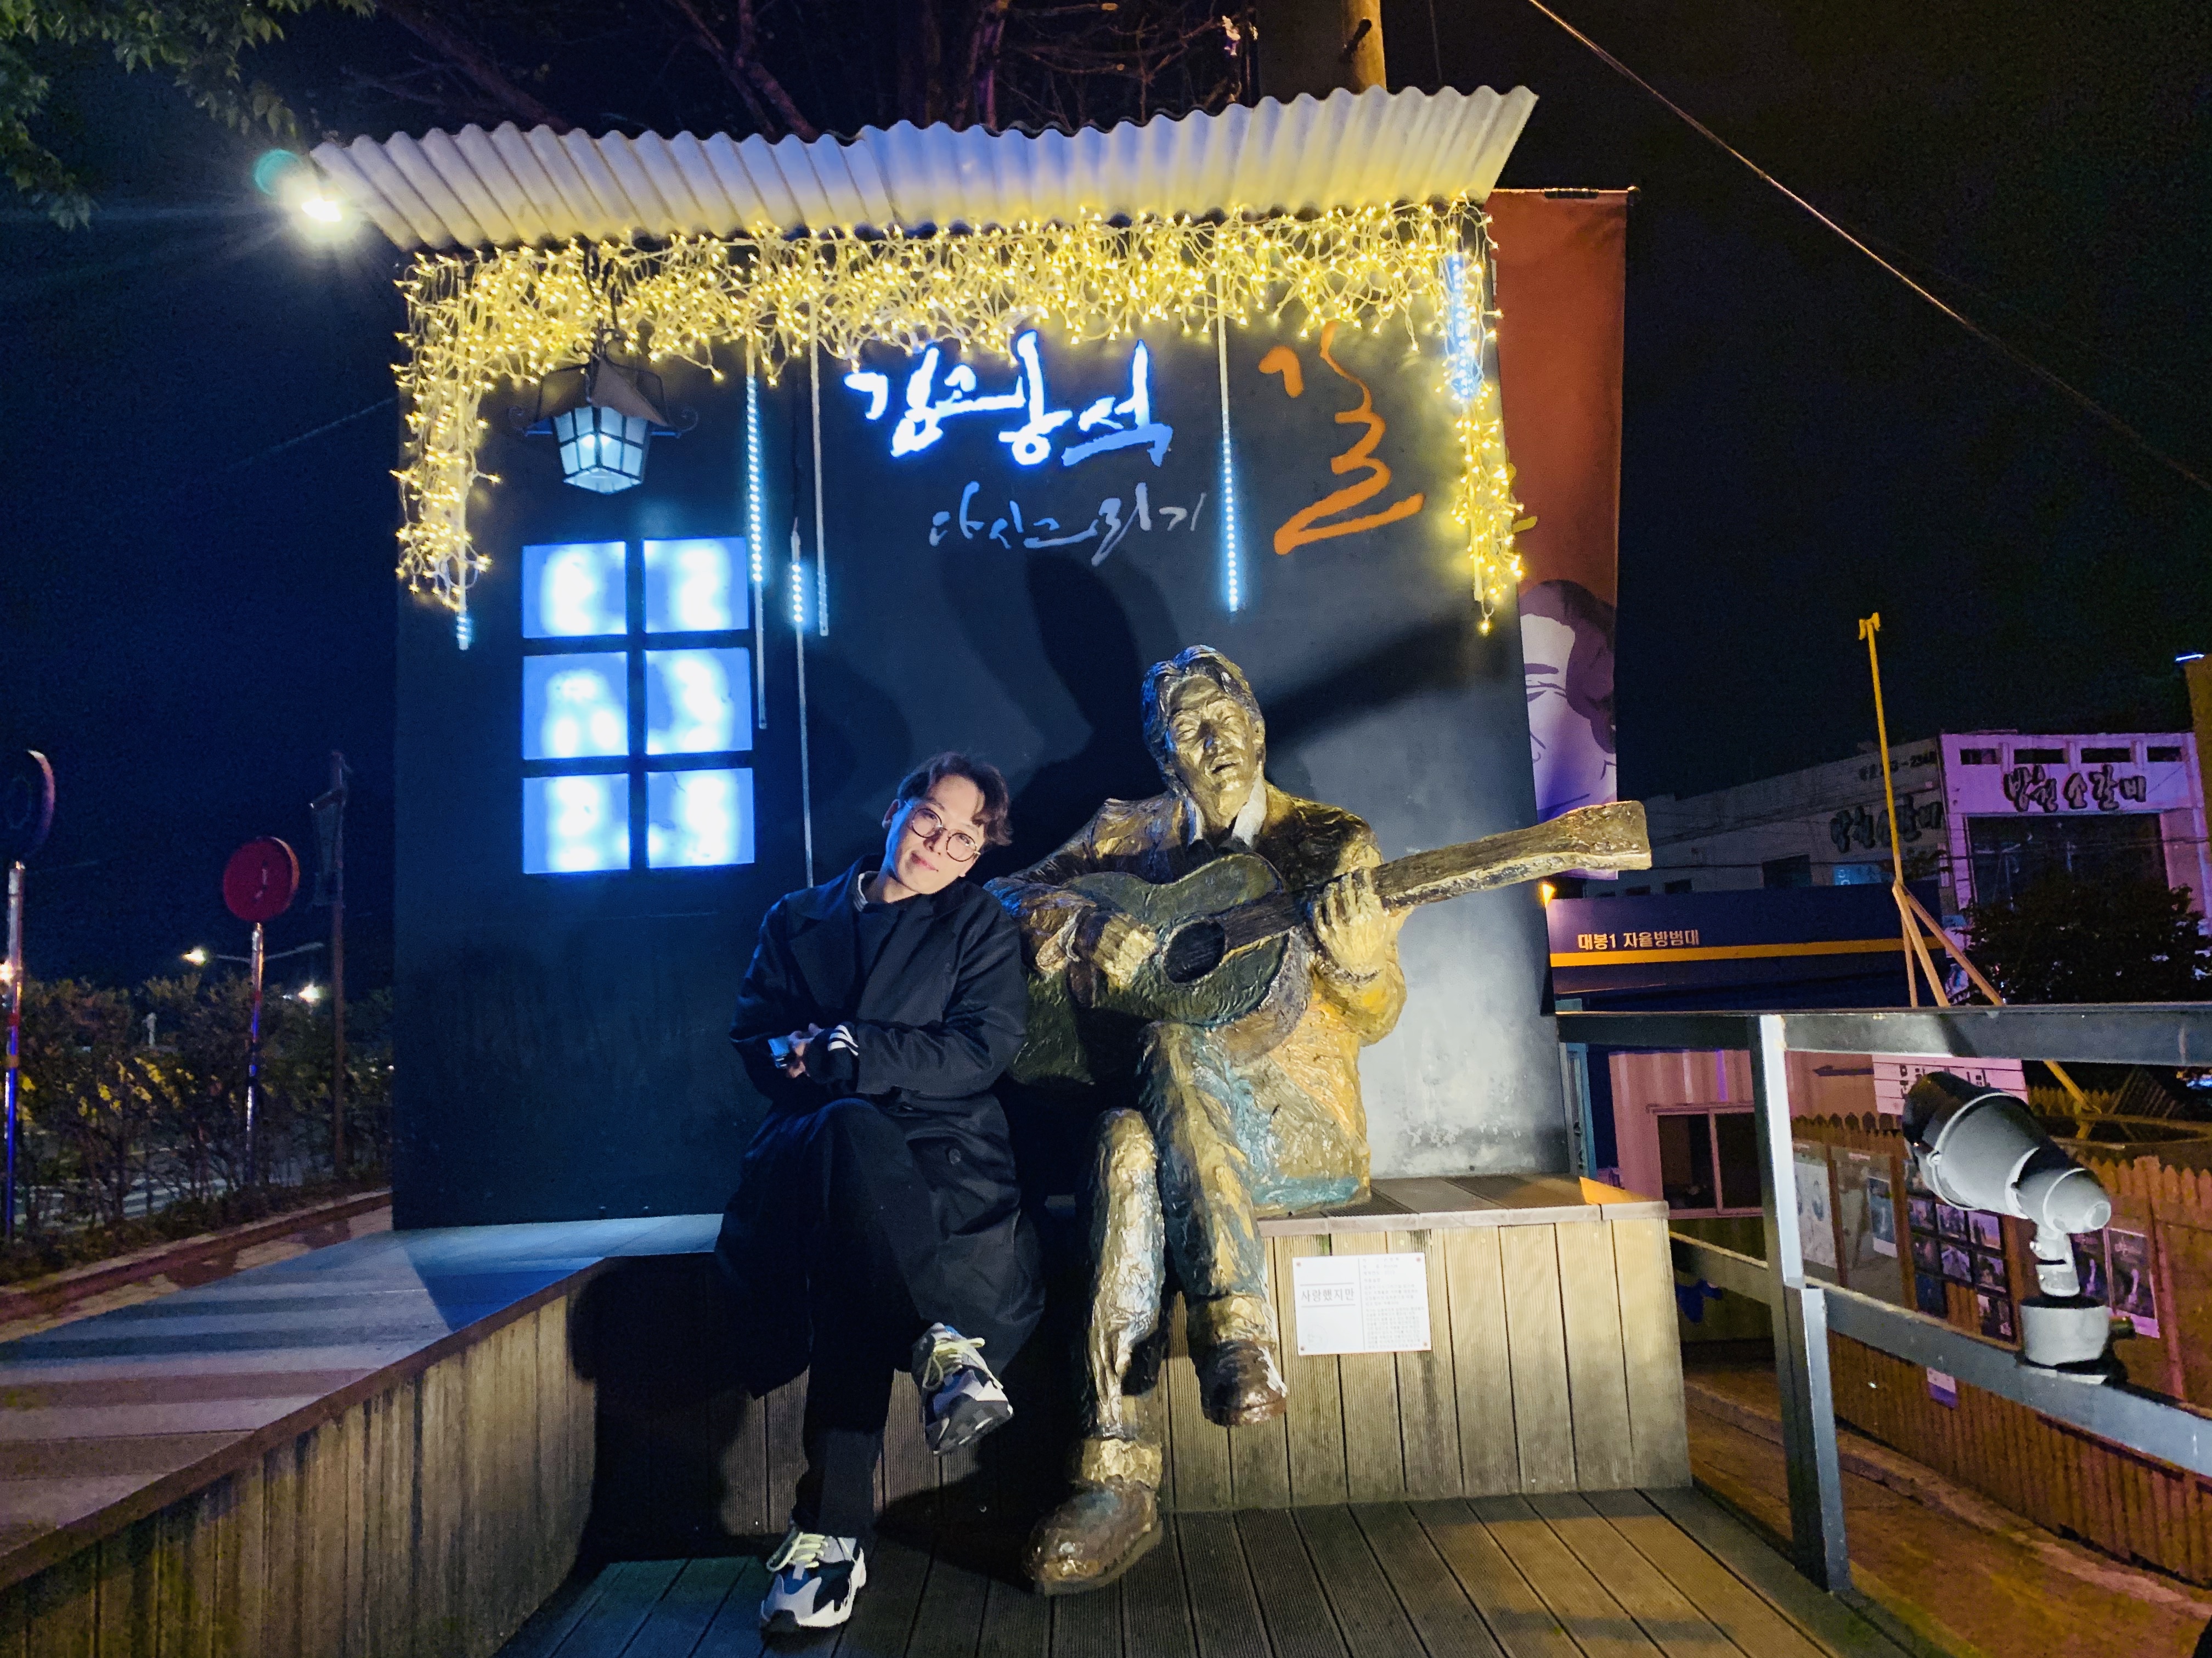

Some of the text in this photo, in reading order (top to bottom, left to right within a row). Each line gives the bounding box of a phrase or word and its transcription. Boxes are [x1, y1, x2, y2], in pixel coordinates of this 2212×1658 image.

[844, 330, 1174, 467] 김광석
[1258, 320, 1426, 555] 길
[1577, 929, 1700, 950] 대봉1 자율방범대
[1301, 1287, 1355, 1302] 사랑했지만
